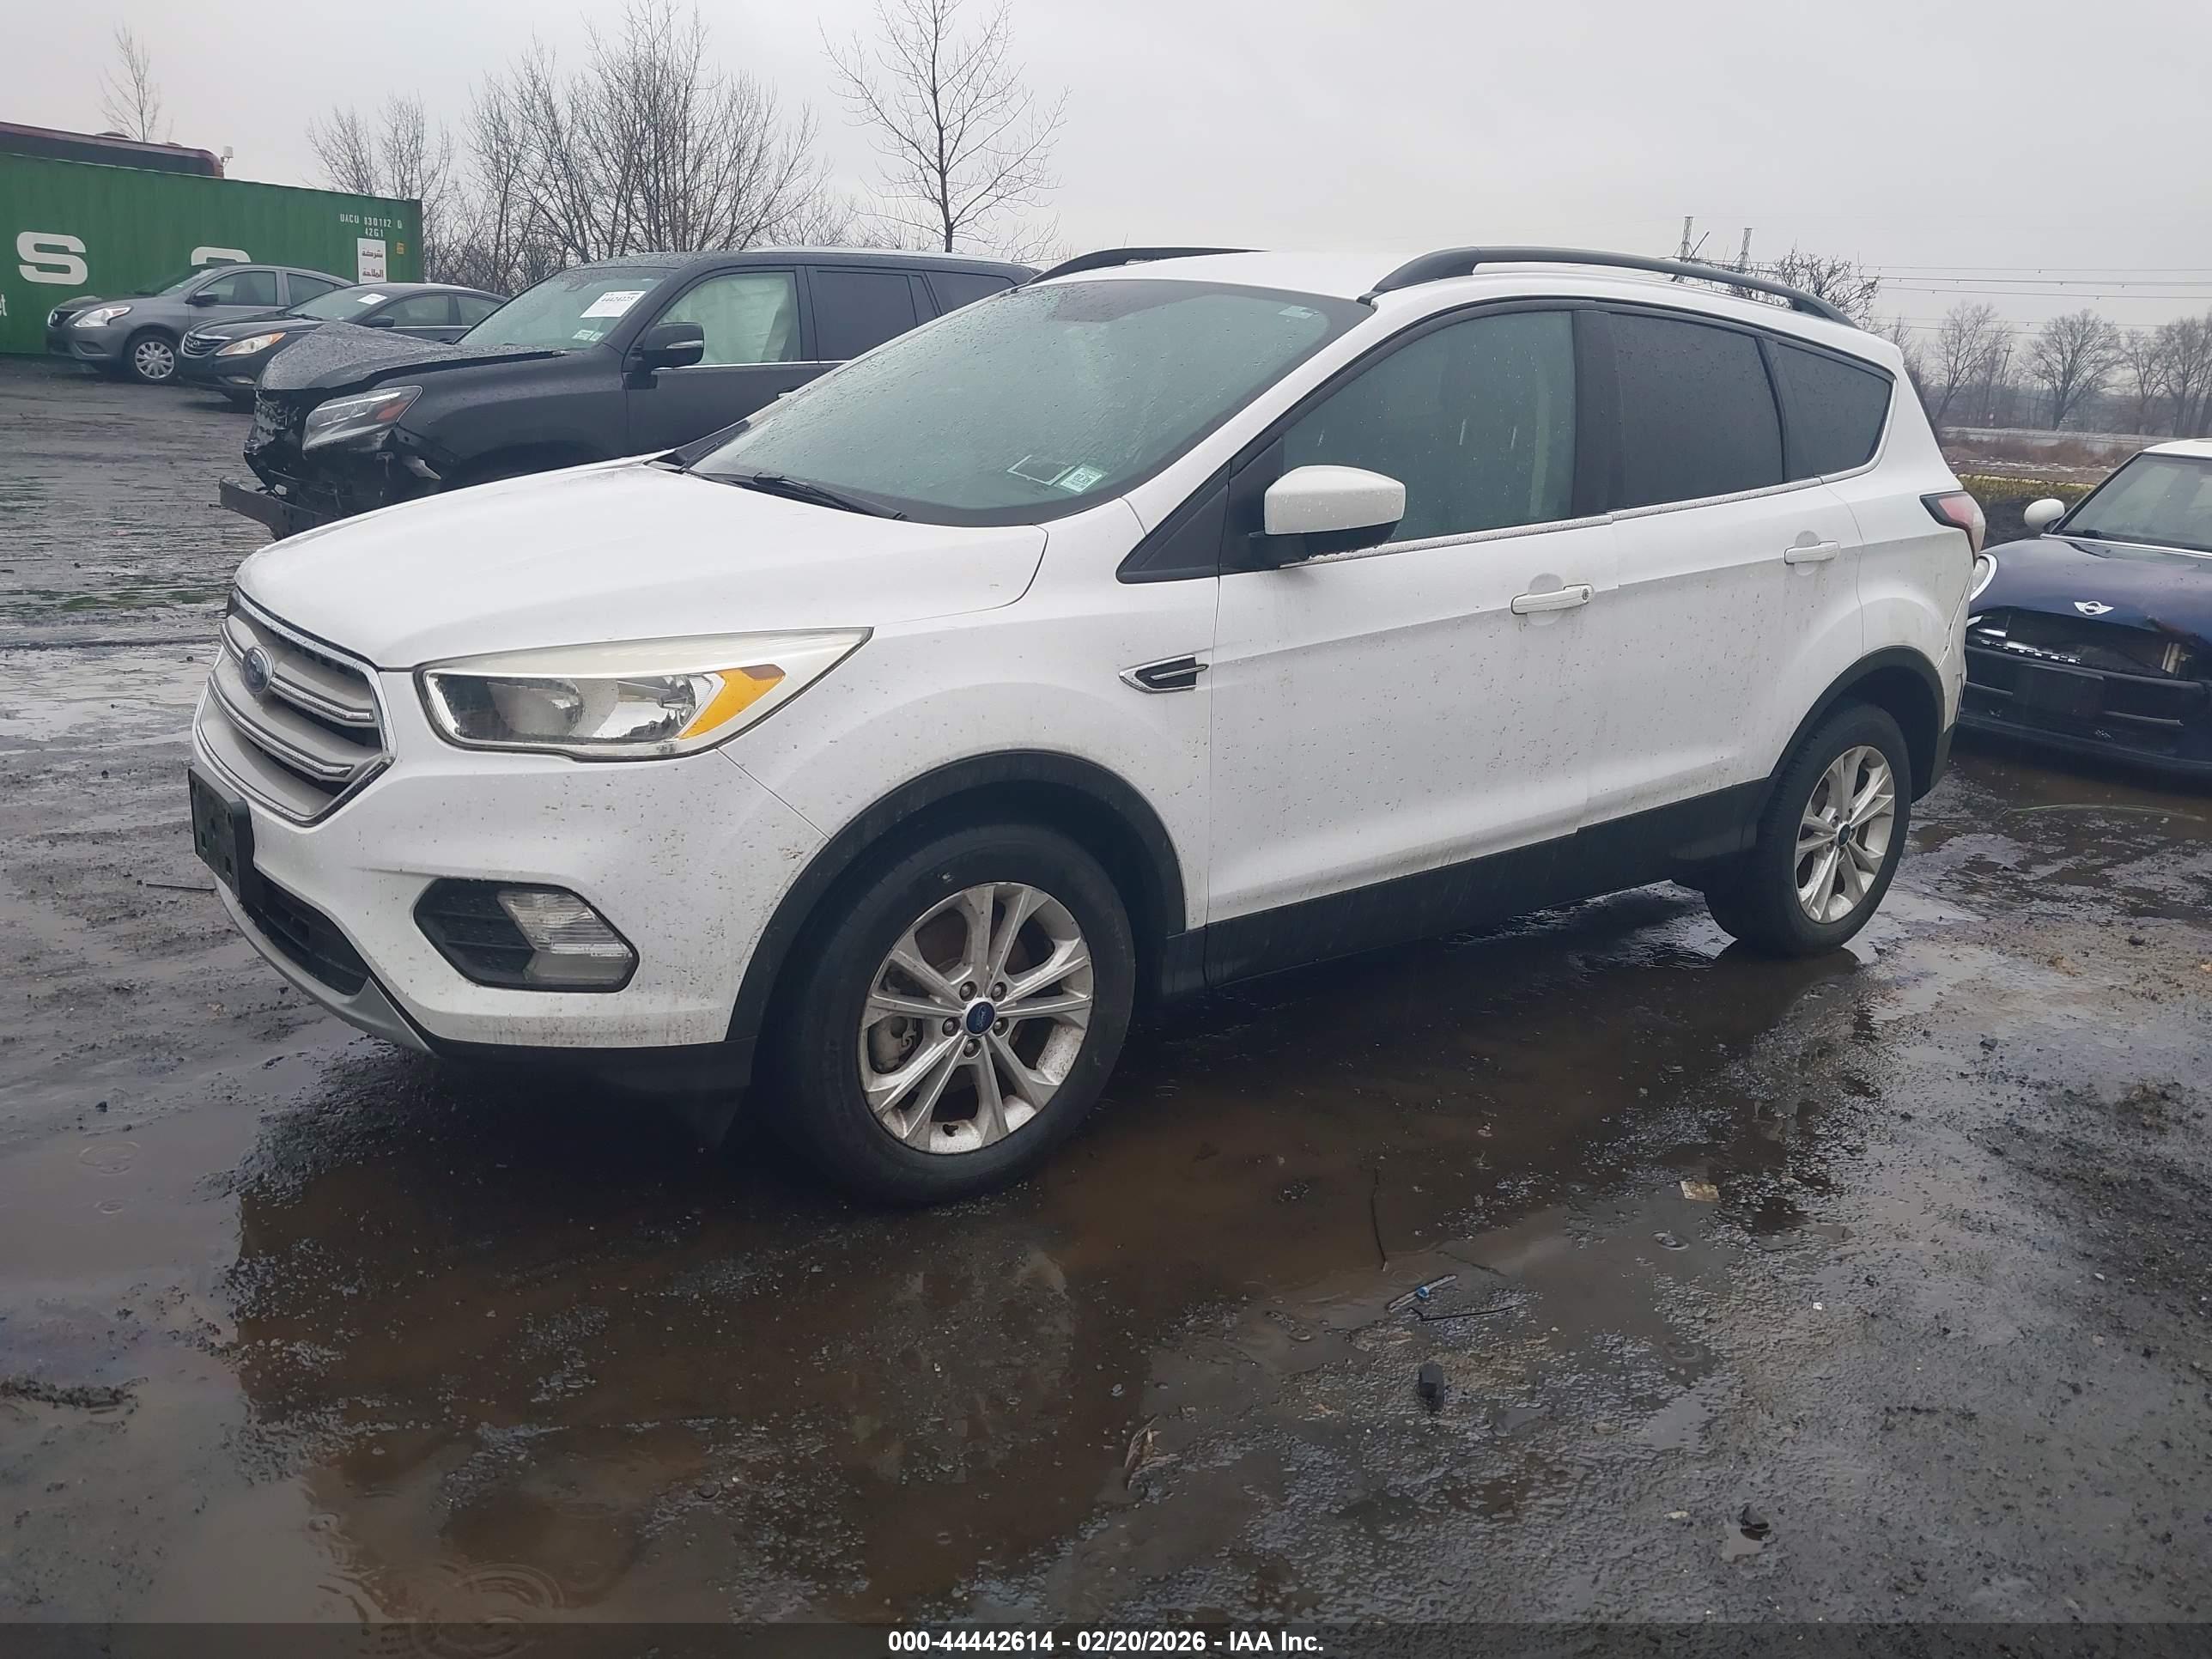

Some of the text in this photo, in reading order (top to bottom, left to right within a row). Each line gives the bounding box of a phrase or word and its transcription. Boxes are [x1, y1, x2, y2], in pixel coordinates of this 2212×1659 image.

[340, 213, 359, 224] UACU
[365, 227, 384, 238] 42G1
[16, 231, 88, 286] S
